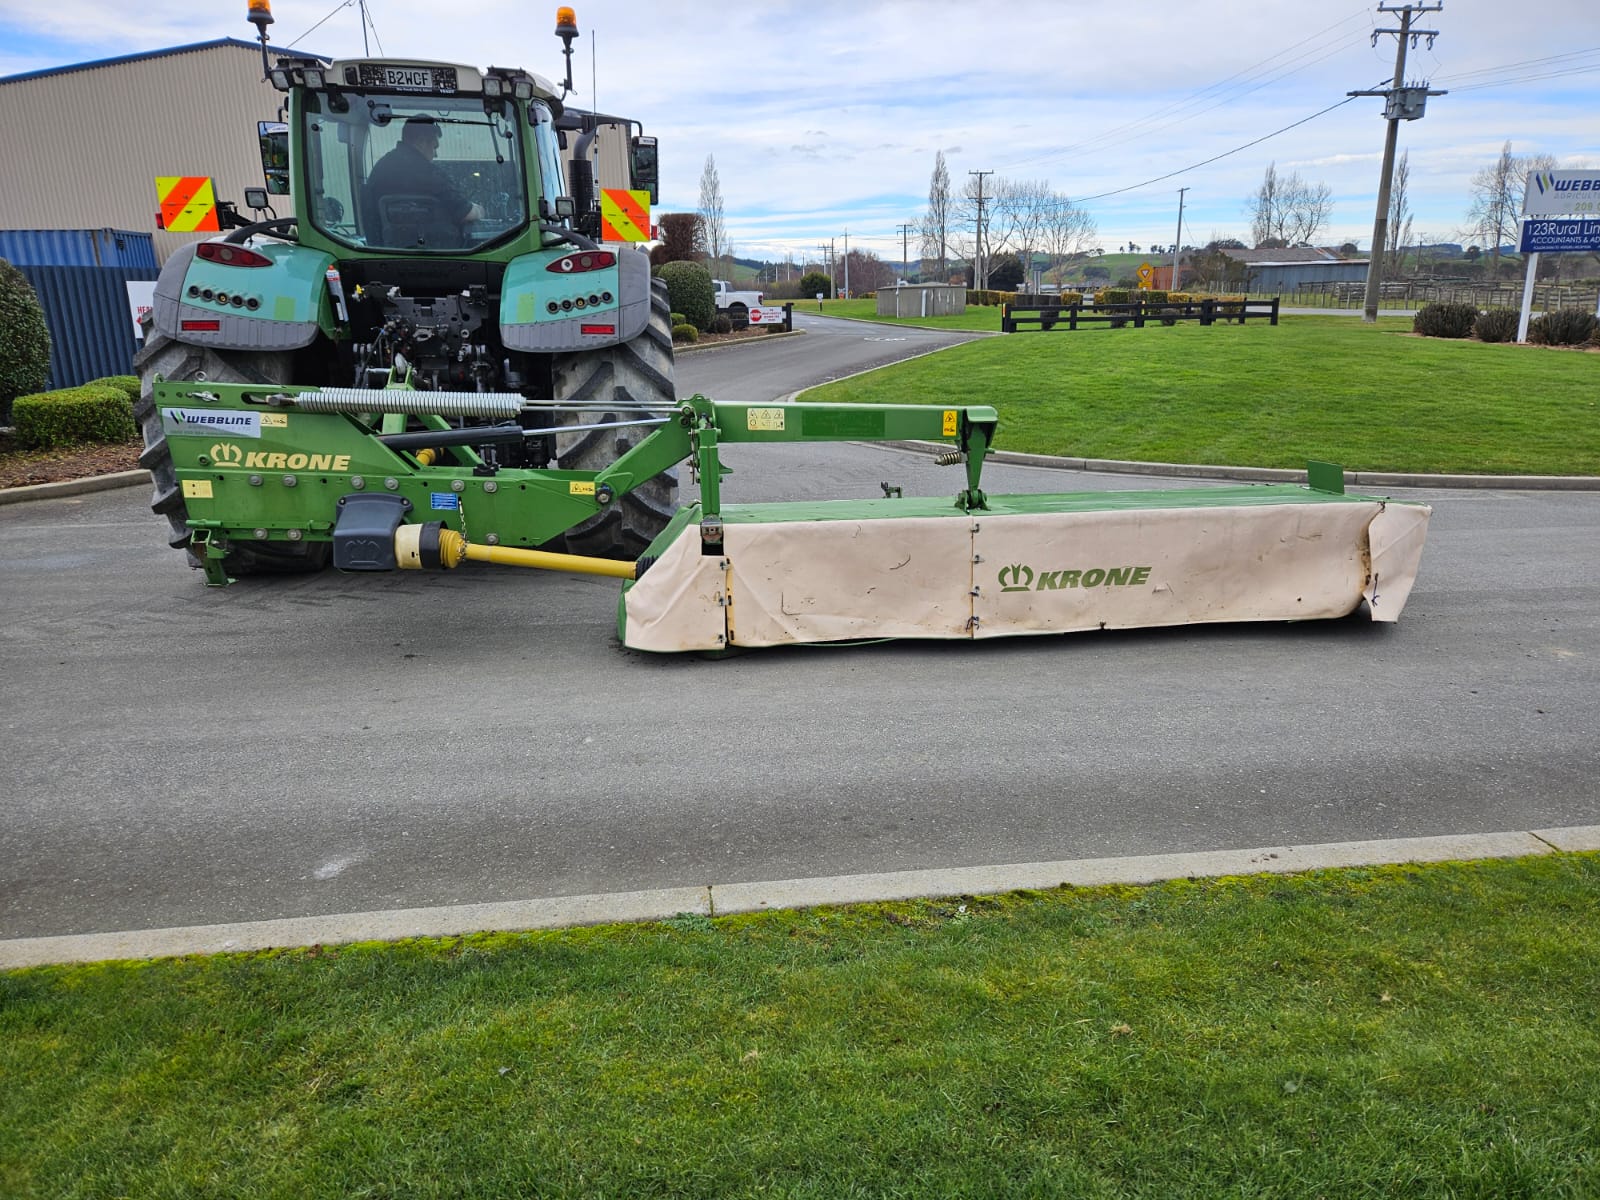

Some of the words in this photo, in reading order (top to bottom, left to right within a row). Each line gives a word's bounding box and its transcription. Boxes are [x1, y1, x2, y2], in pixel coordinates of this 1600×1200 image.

[388, 70, 428, 86] B2WCF
[1528, 222, 1581, 235] 123Rural
[1531, 236, 1581, 244] ACCOUNTANTS
[187, 416, 252, 425] WEBBLINE
[245, 452, 351, 471] KRONE
[1036, 566, 1153, 591] KRONE
